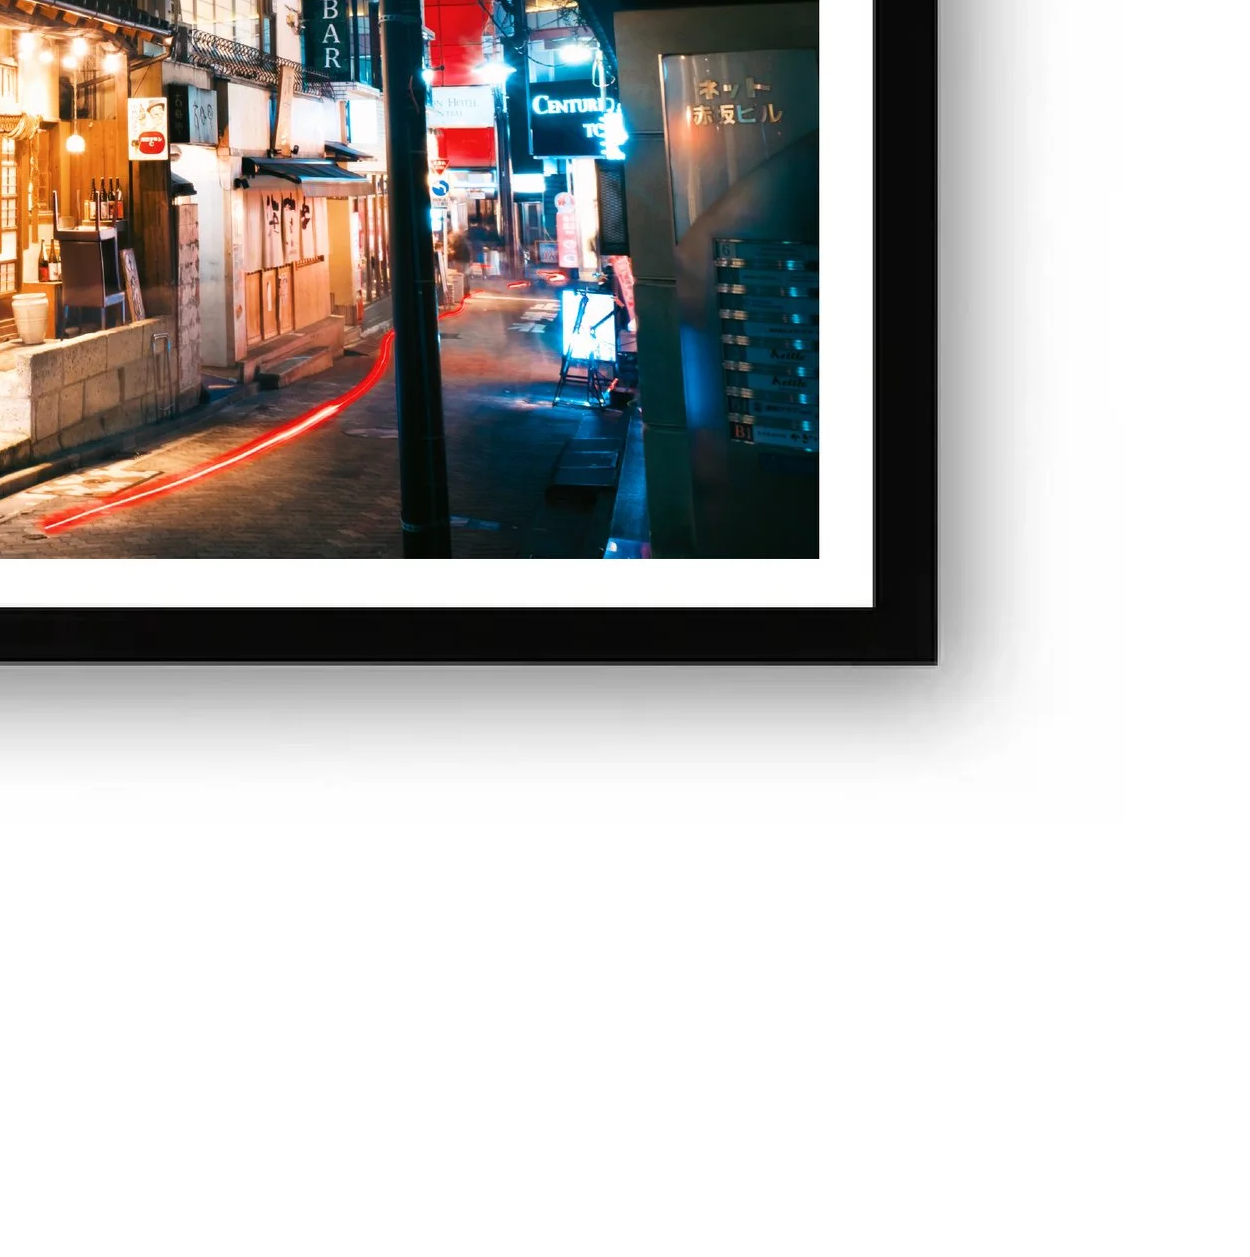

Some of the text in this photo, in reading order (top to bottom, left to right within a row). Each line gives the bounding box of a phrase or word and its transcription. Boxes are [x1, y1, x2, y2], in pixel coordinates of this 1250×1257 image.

[698, 77, 773, 100] ネット
[721, 244, 731, 257] 6
[734, 424, 752, 440] B1
